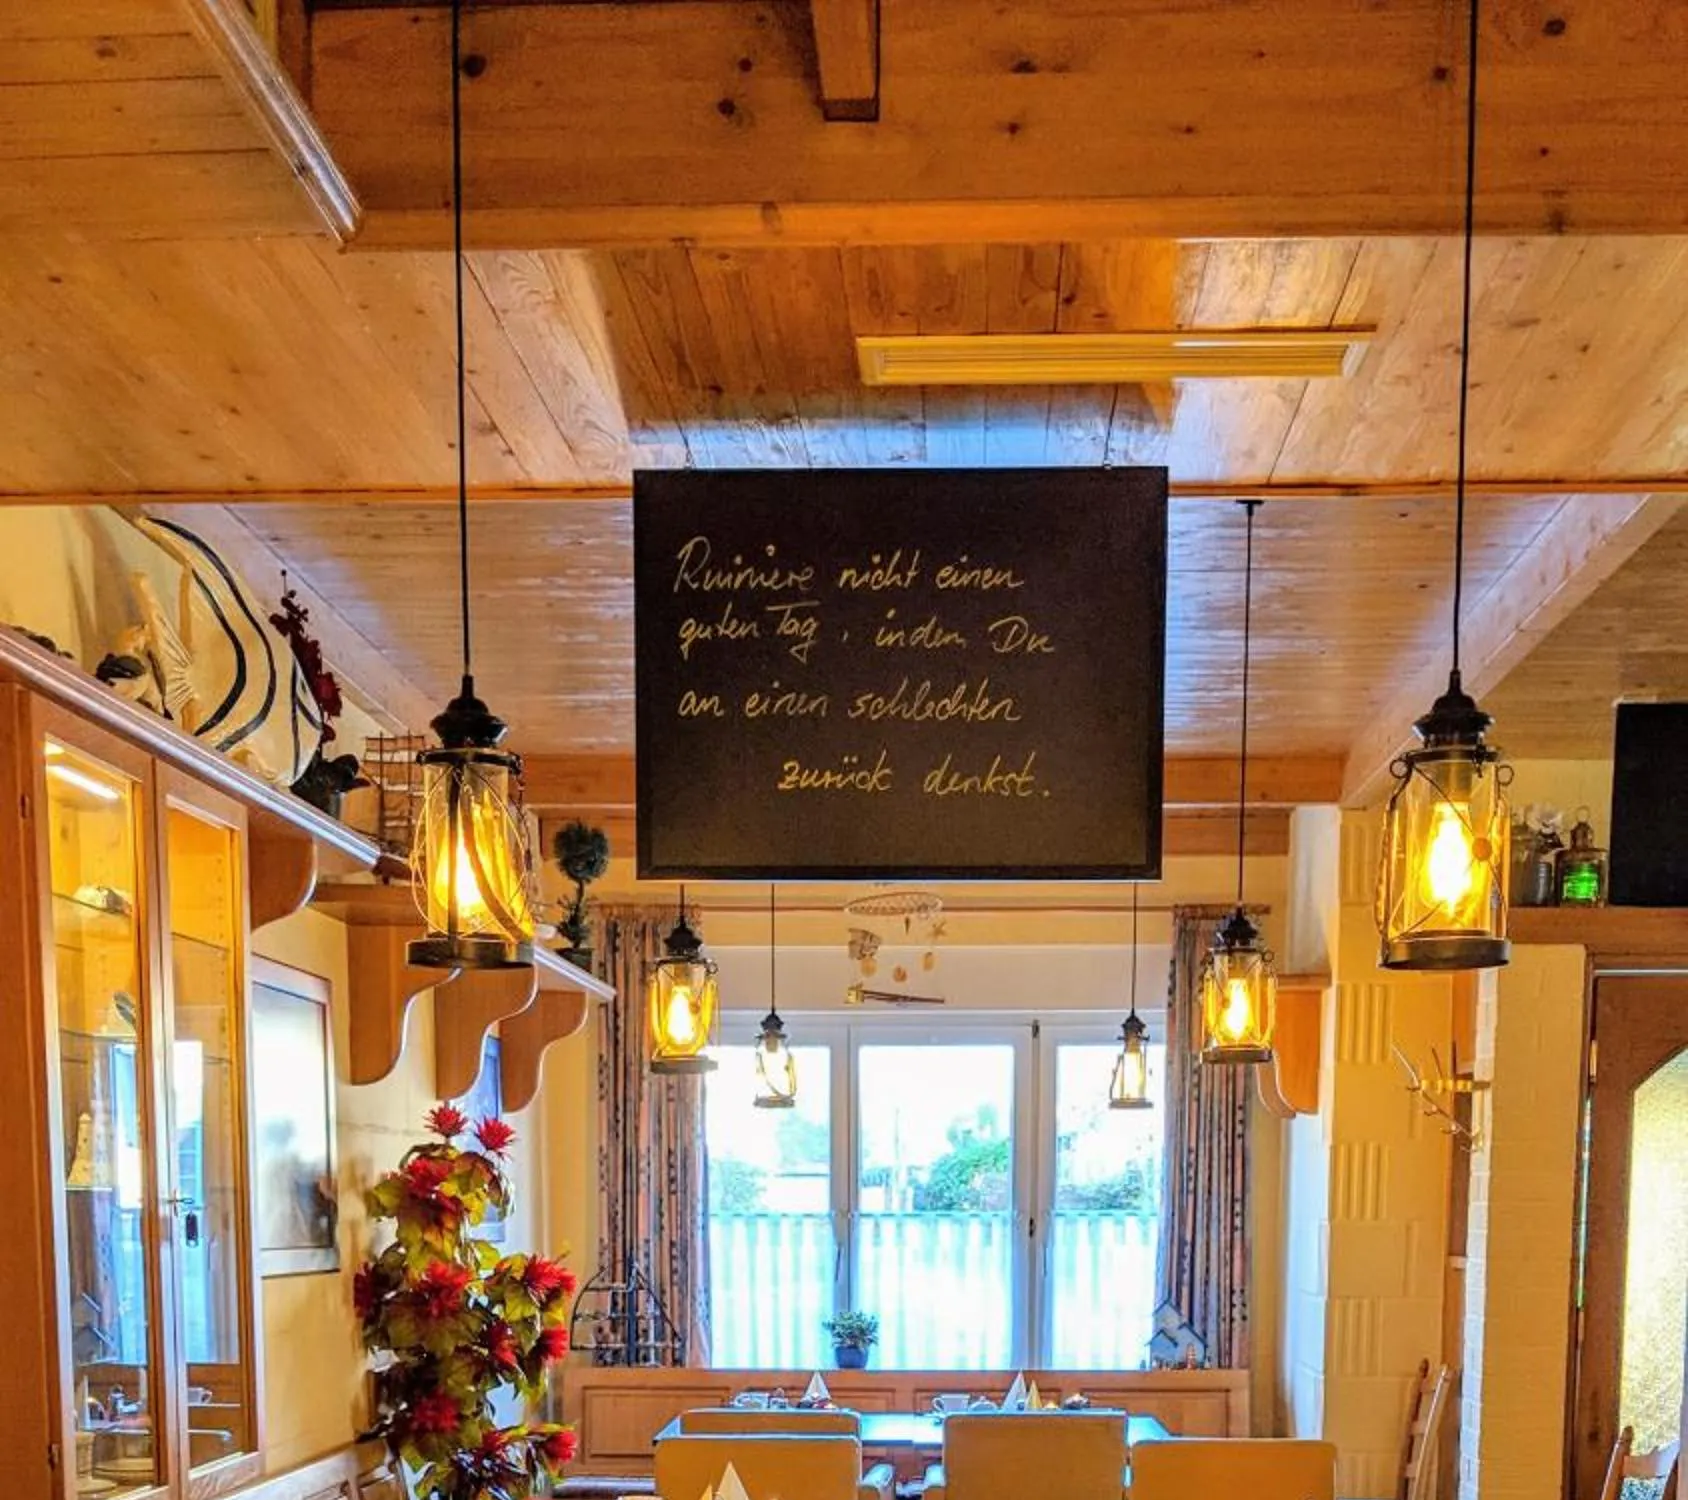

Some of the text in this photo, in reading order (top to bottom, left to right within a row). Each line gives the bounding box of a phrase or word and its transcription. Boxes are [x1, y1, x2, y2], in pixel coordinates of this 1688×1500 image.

[838, 550, 921, 590] nicht
[936, 555, 1025, 589] einen
[678, 601, 759, 660] guten
[874, 608, 968, 649] indem
[988, 615, 1056, 655] Du
[677, 676, 1023, 722] an einen schlechten
